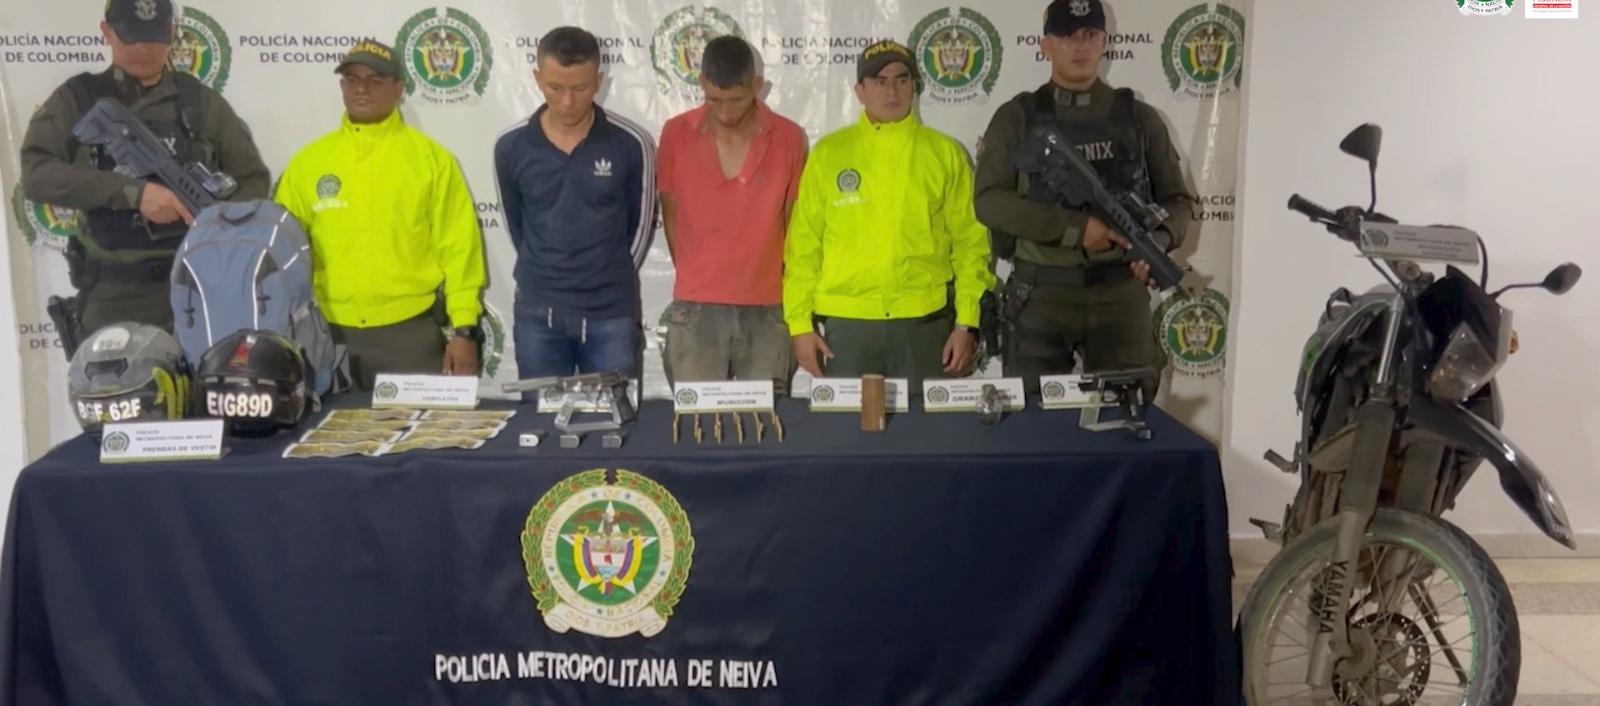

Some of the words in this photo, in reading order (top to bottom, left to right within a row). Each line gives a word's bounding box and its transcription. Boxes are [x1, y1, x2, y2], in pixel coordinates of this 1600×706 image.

[44, 35, 110, 47] NACION
[1108, 33, 1154, 45] IONAL
[5, 51, 25, 63] DE
[27, 51, 106, 63] COLOMBIA
[260, 52, 279, 63] DE
[283, 52, 346, 63] COLOMB
[30, 338, 49, 349] DE
[206, 391, 273, 418] EIG89D
[1318, 559, 1349, 635] YAMAHA
[435, 652, 510, 683] POLICIA
[517, 651, 678, 687] METROPOLITANA
[688, 659, 713, 687] DE
[719, 660, 778, 688] NEIVA
